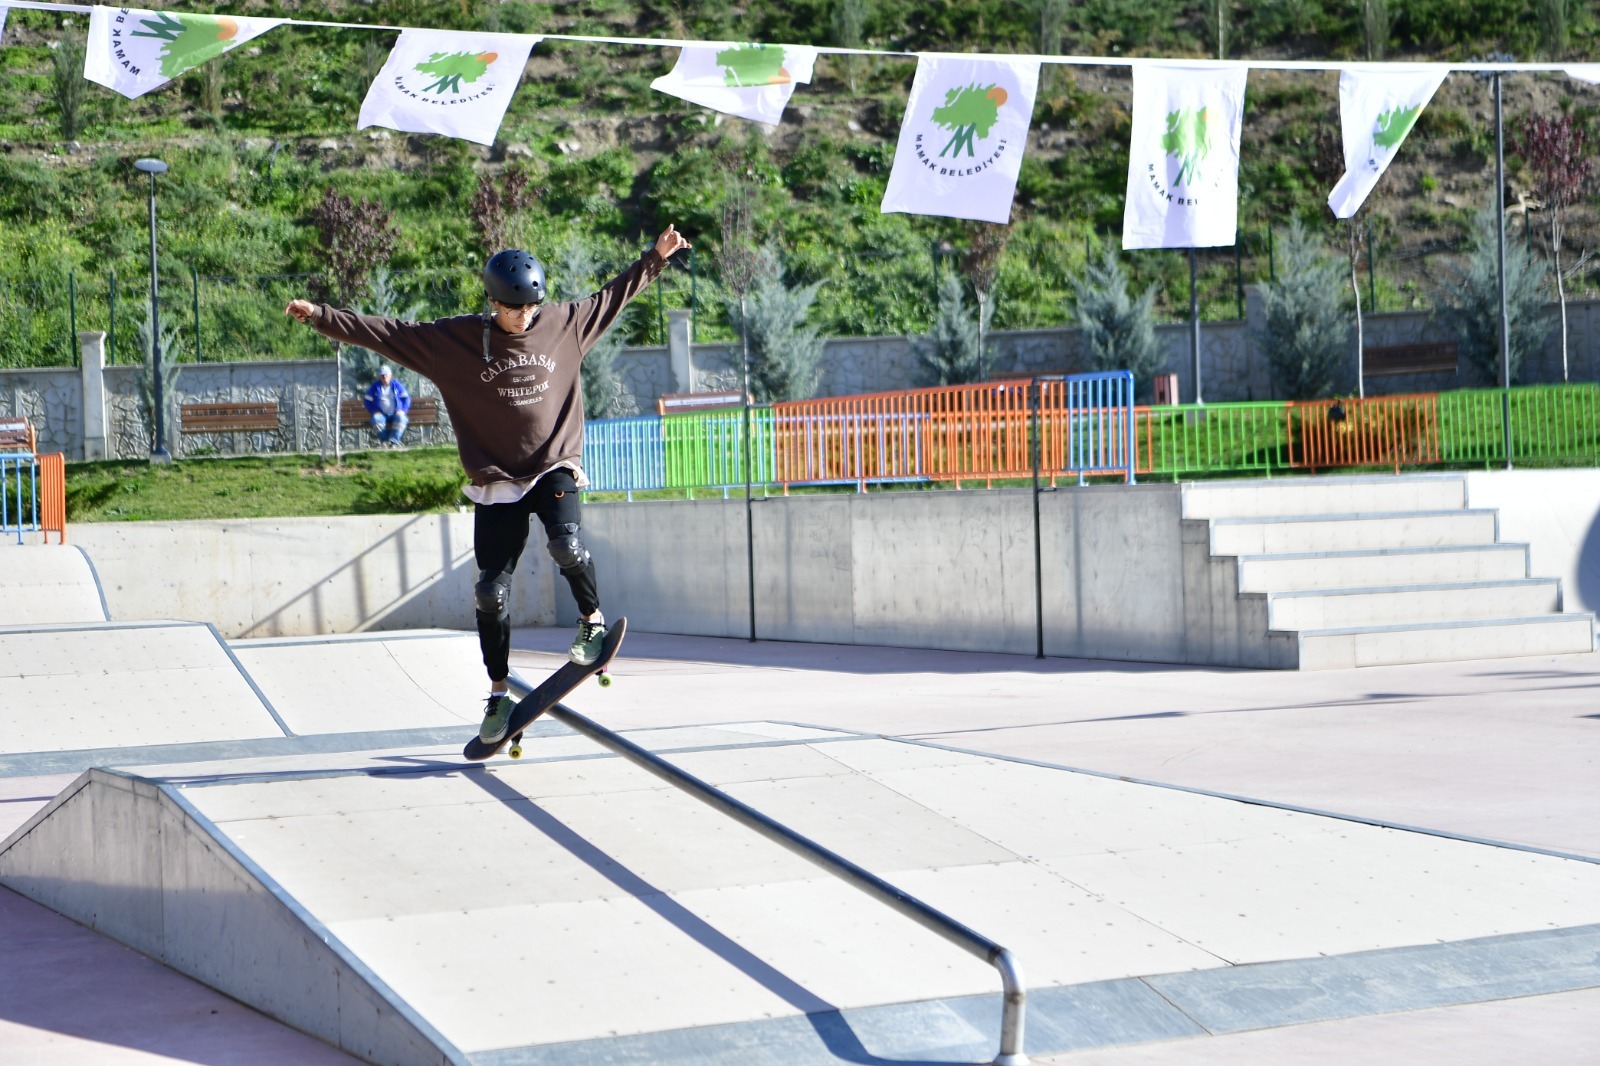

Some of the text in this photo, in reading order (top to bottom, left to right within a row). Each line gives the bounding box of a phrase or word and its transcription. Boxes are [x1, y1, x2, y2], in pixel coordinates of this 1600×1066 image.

[915, 134, 937, 171] MAMAK
[1148, 163, 1173, 202] MAMAK
[480, 354, 556, 383] CALABASAS
